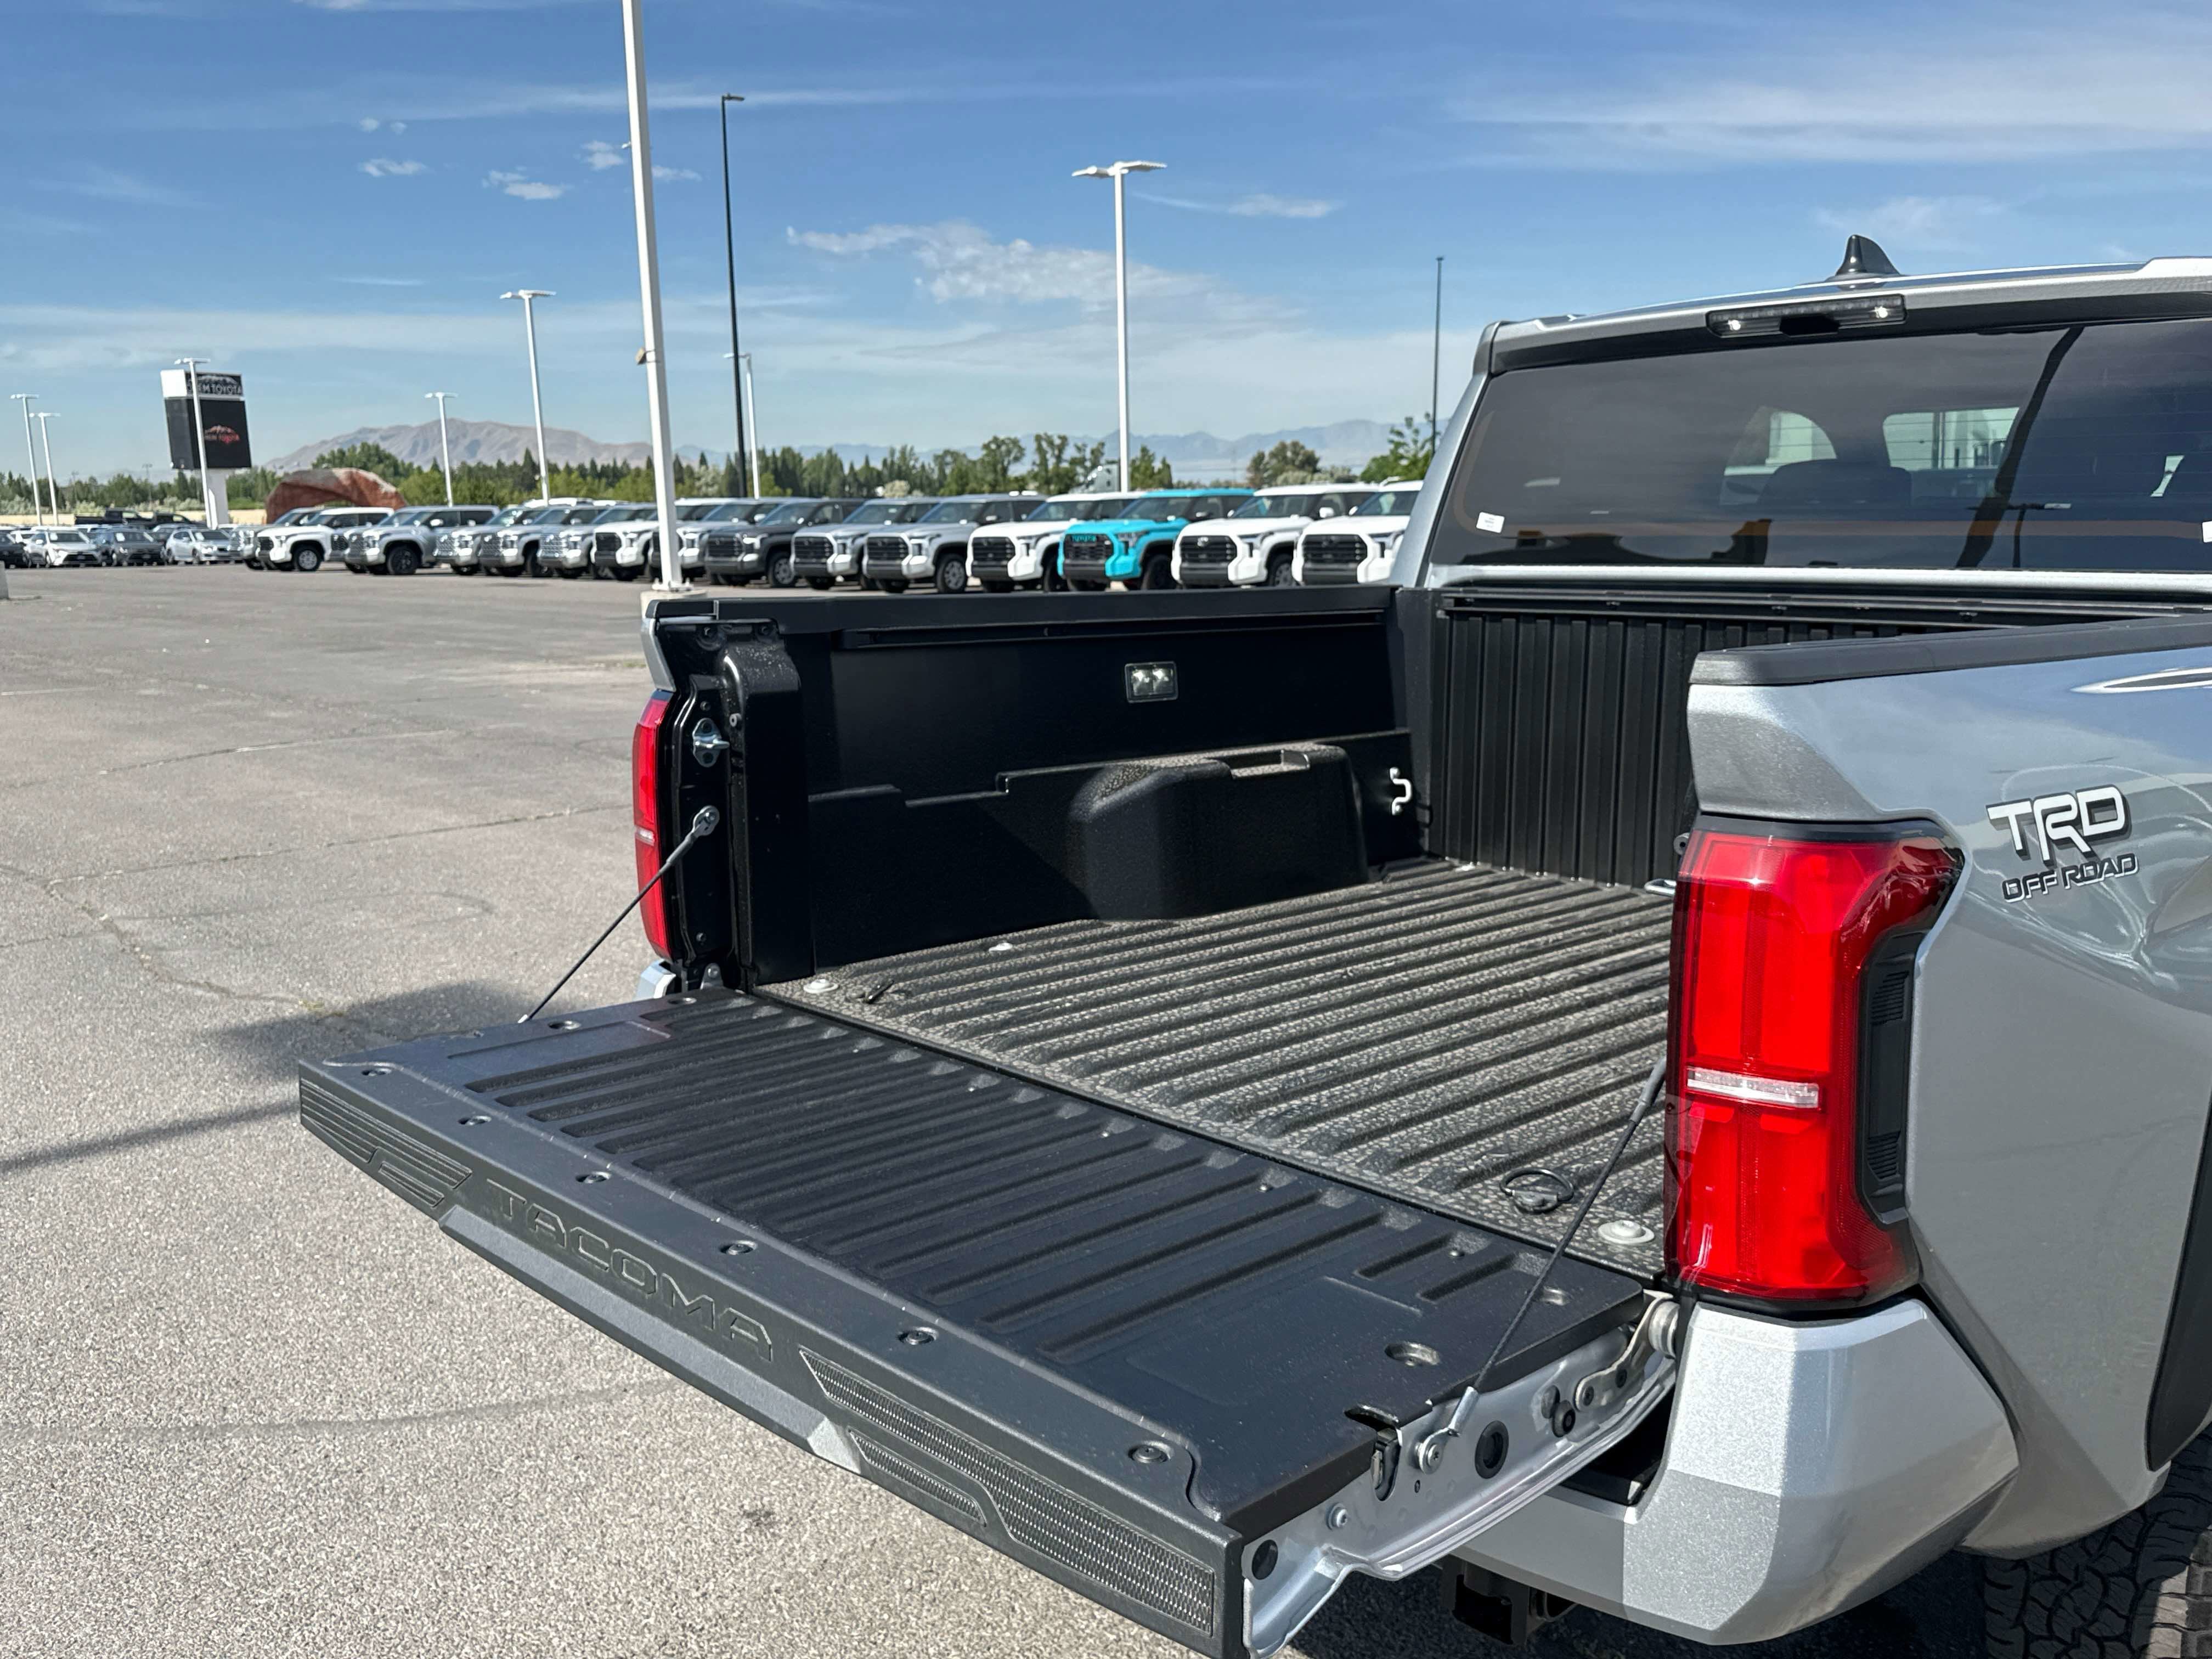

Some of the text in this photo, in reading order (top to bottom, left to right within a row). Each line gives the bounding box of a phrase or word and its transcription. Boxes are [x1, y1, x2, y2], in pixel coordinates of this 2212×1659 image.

[1986, 785, 2131, 867] TRD
[2002, 853, 2138, 902] OFF ROAD
[487, 1178, 773, 1363] TACOMA
